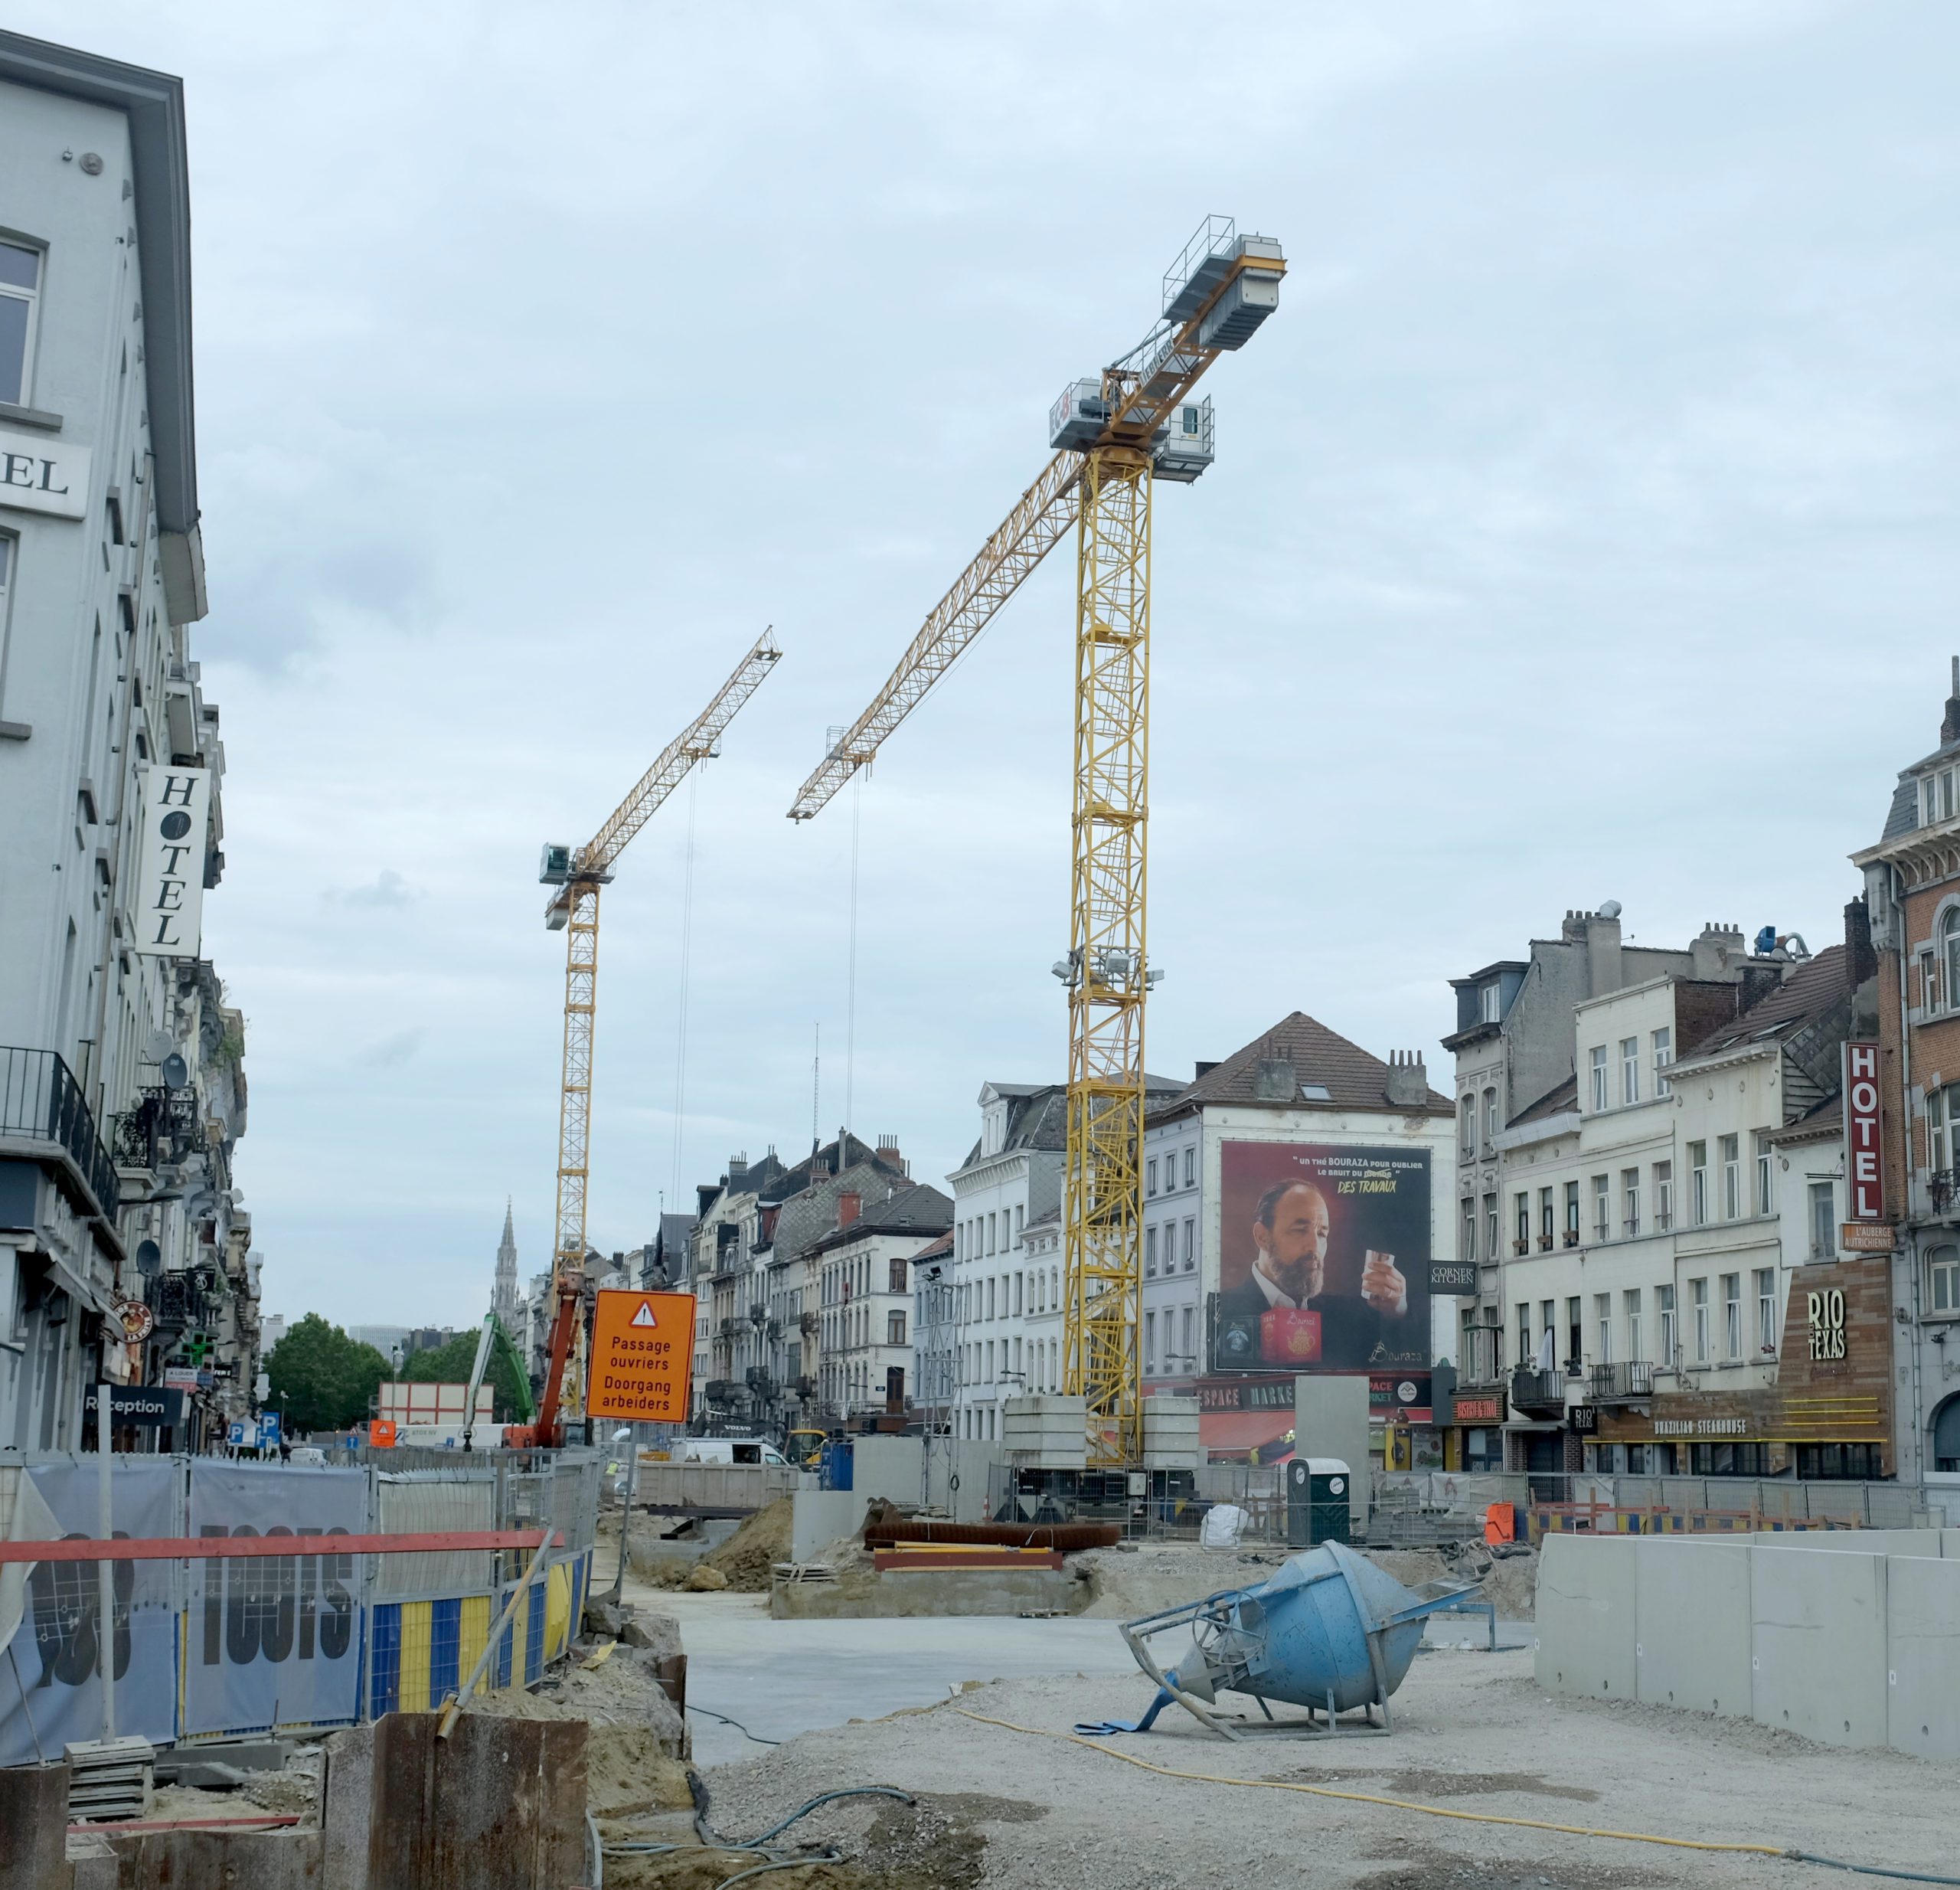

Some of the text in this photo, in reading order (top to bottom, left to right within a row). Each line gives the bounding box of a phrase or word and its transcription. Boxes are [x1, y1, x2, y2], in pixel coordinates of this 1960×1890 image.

[1139, 338, 1174, 385] LIEBHERR
[152, 775, 199, 946] HOTEL
[1851, 1048, 1878, 1218] HOTEL
[1328, 1157, 1369, 1167] BOURAZA
[1337, 1180, 1396, 1194] DES TRAVAUX
[1856, 1227, 1892, 1238] L'AUBERGE
[1844, 1237, 1892, 1248] AUTRICHIENNE
[1431, 1274, 1473, 1283] KITCHEN
[1432, 1267, 1473, 1277] CORNER
[1807, 1289, 1844, 1330] RIO
[612, 1336, 671, 1355] Passage
[1808, 1329, 1846, 1361] TEXAS
[610, 1356, 669, 1371] ouvriers
[604, 1375, 671, 1396] Doorgang
[1250, 1385, 1295, 1405] MARKE
[602, 1395, 670, 1411] arbeiders
[1575, 1409, 1592, 1420] RIO
[263, 1416, 277, 1434] P
[1575, 1418, 1593, 1428] TEXAS
[1655, 1419, 1746, 1434] BRAZILIAN STEAKHOUSE
[231, 1426, 243, 1440] P
